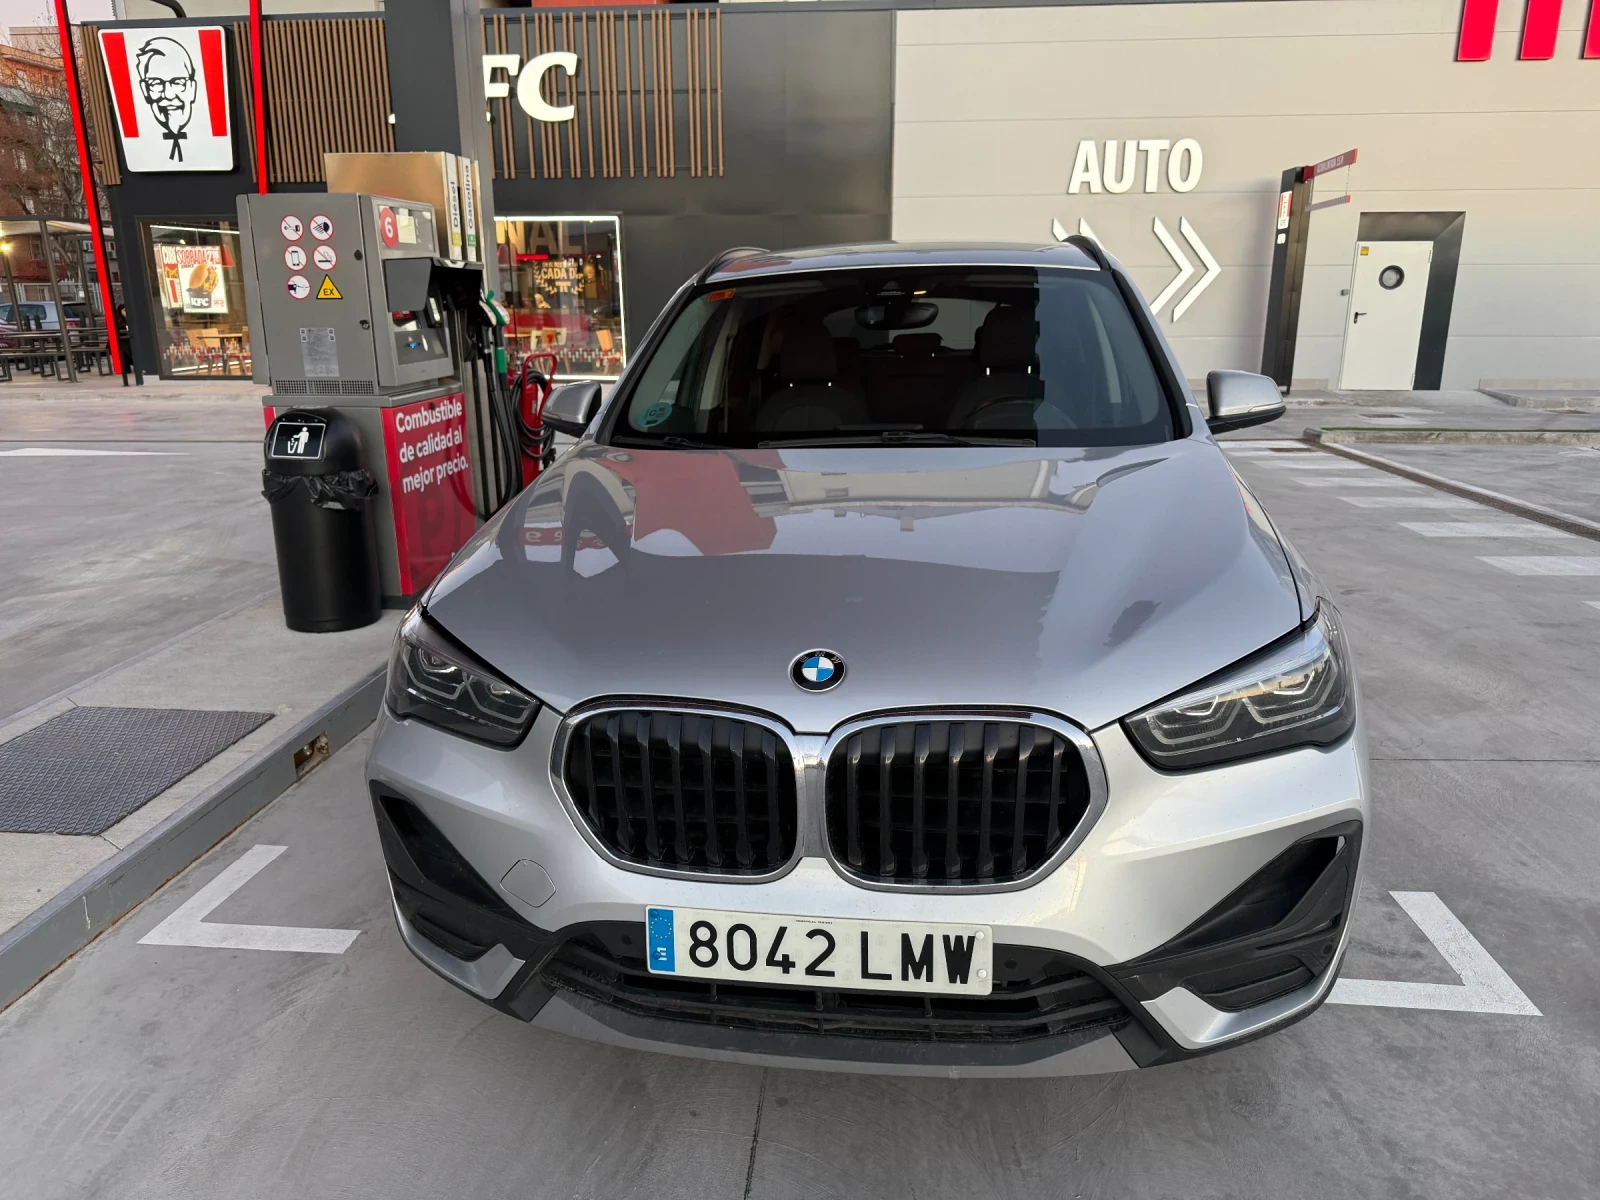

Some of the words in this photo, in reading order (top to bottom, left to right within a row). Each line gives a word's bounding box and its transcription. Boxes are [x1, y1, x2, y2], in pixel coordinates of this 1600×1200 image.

[1068, 138, 1203, 194] AUTO
[465, 165, 473, 229] Gasolina
[385, 217, 394, 238] 6
[541, 268, 567, 280] CADA
[191, 298, 209, 307] KFC
[396, 399, 462, 433] Combustible
[400, 442, 415, 463] de
[416, 428, 453, 458] calidad
[454, 425, 463, 443] al
[402, 466, 434, 493] mejor
[436, 453, 469, 485] precio.
[689, 920, 837, 978] 8042
[860, 931, 976, 985] LMW
